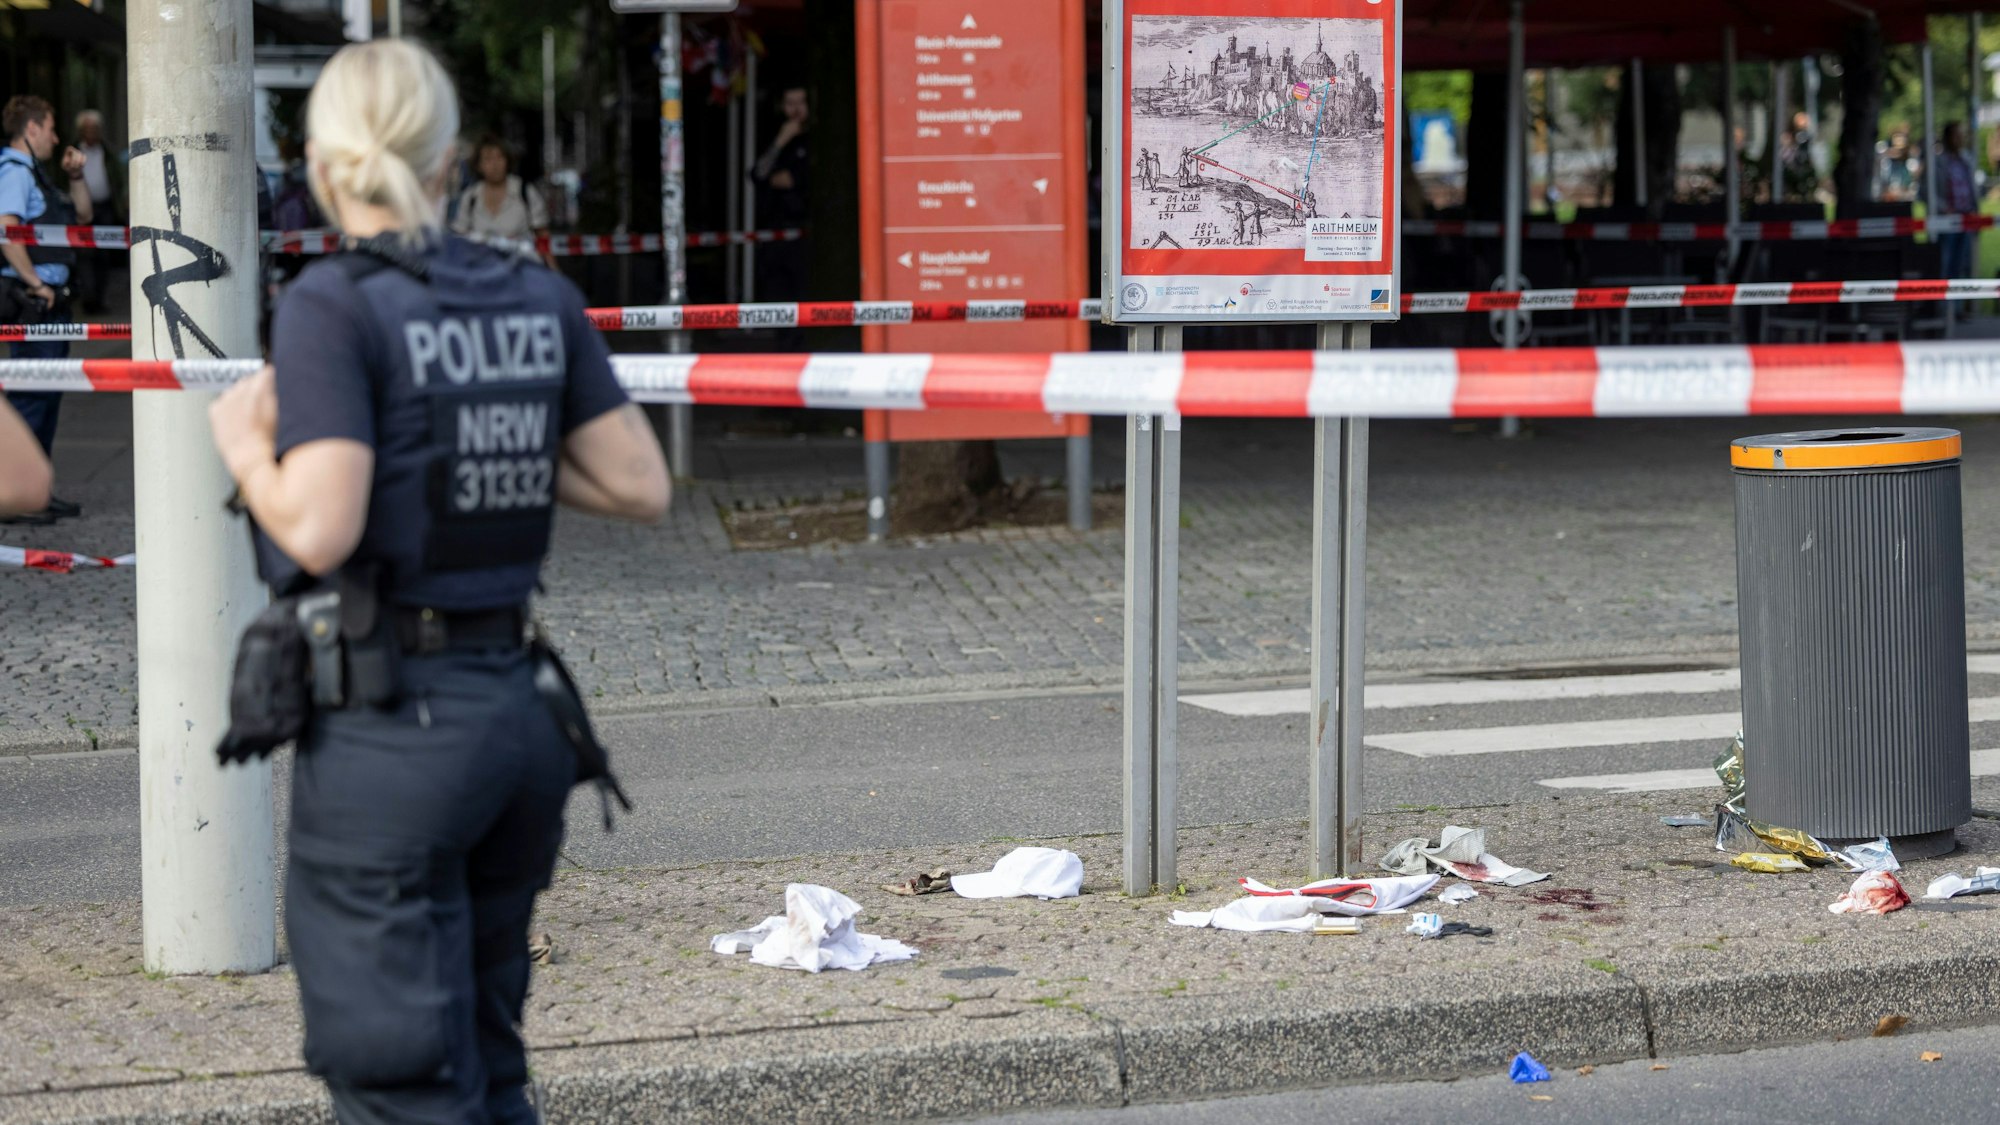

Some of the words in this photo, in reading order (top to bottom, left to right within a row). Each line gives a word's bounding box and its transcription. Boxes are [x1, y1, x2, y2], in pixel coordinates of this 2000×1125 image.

[1199, 163, 1206, 171] C
[1311, 222, 1378, 233] ARITHMEUM
[673, 307, 795, 327] POLIZEIABSPERRUNG
[404, 314, 566, 387] POLIZEI
[457, 402, 548, 455] NRW
[454, 457, 552, 511] 31332
